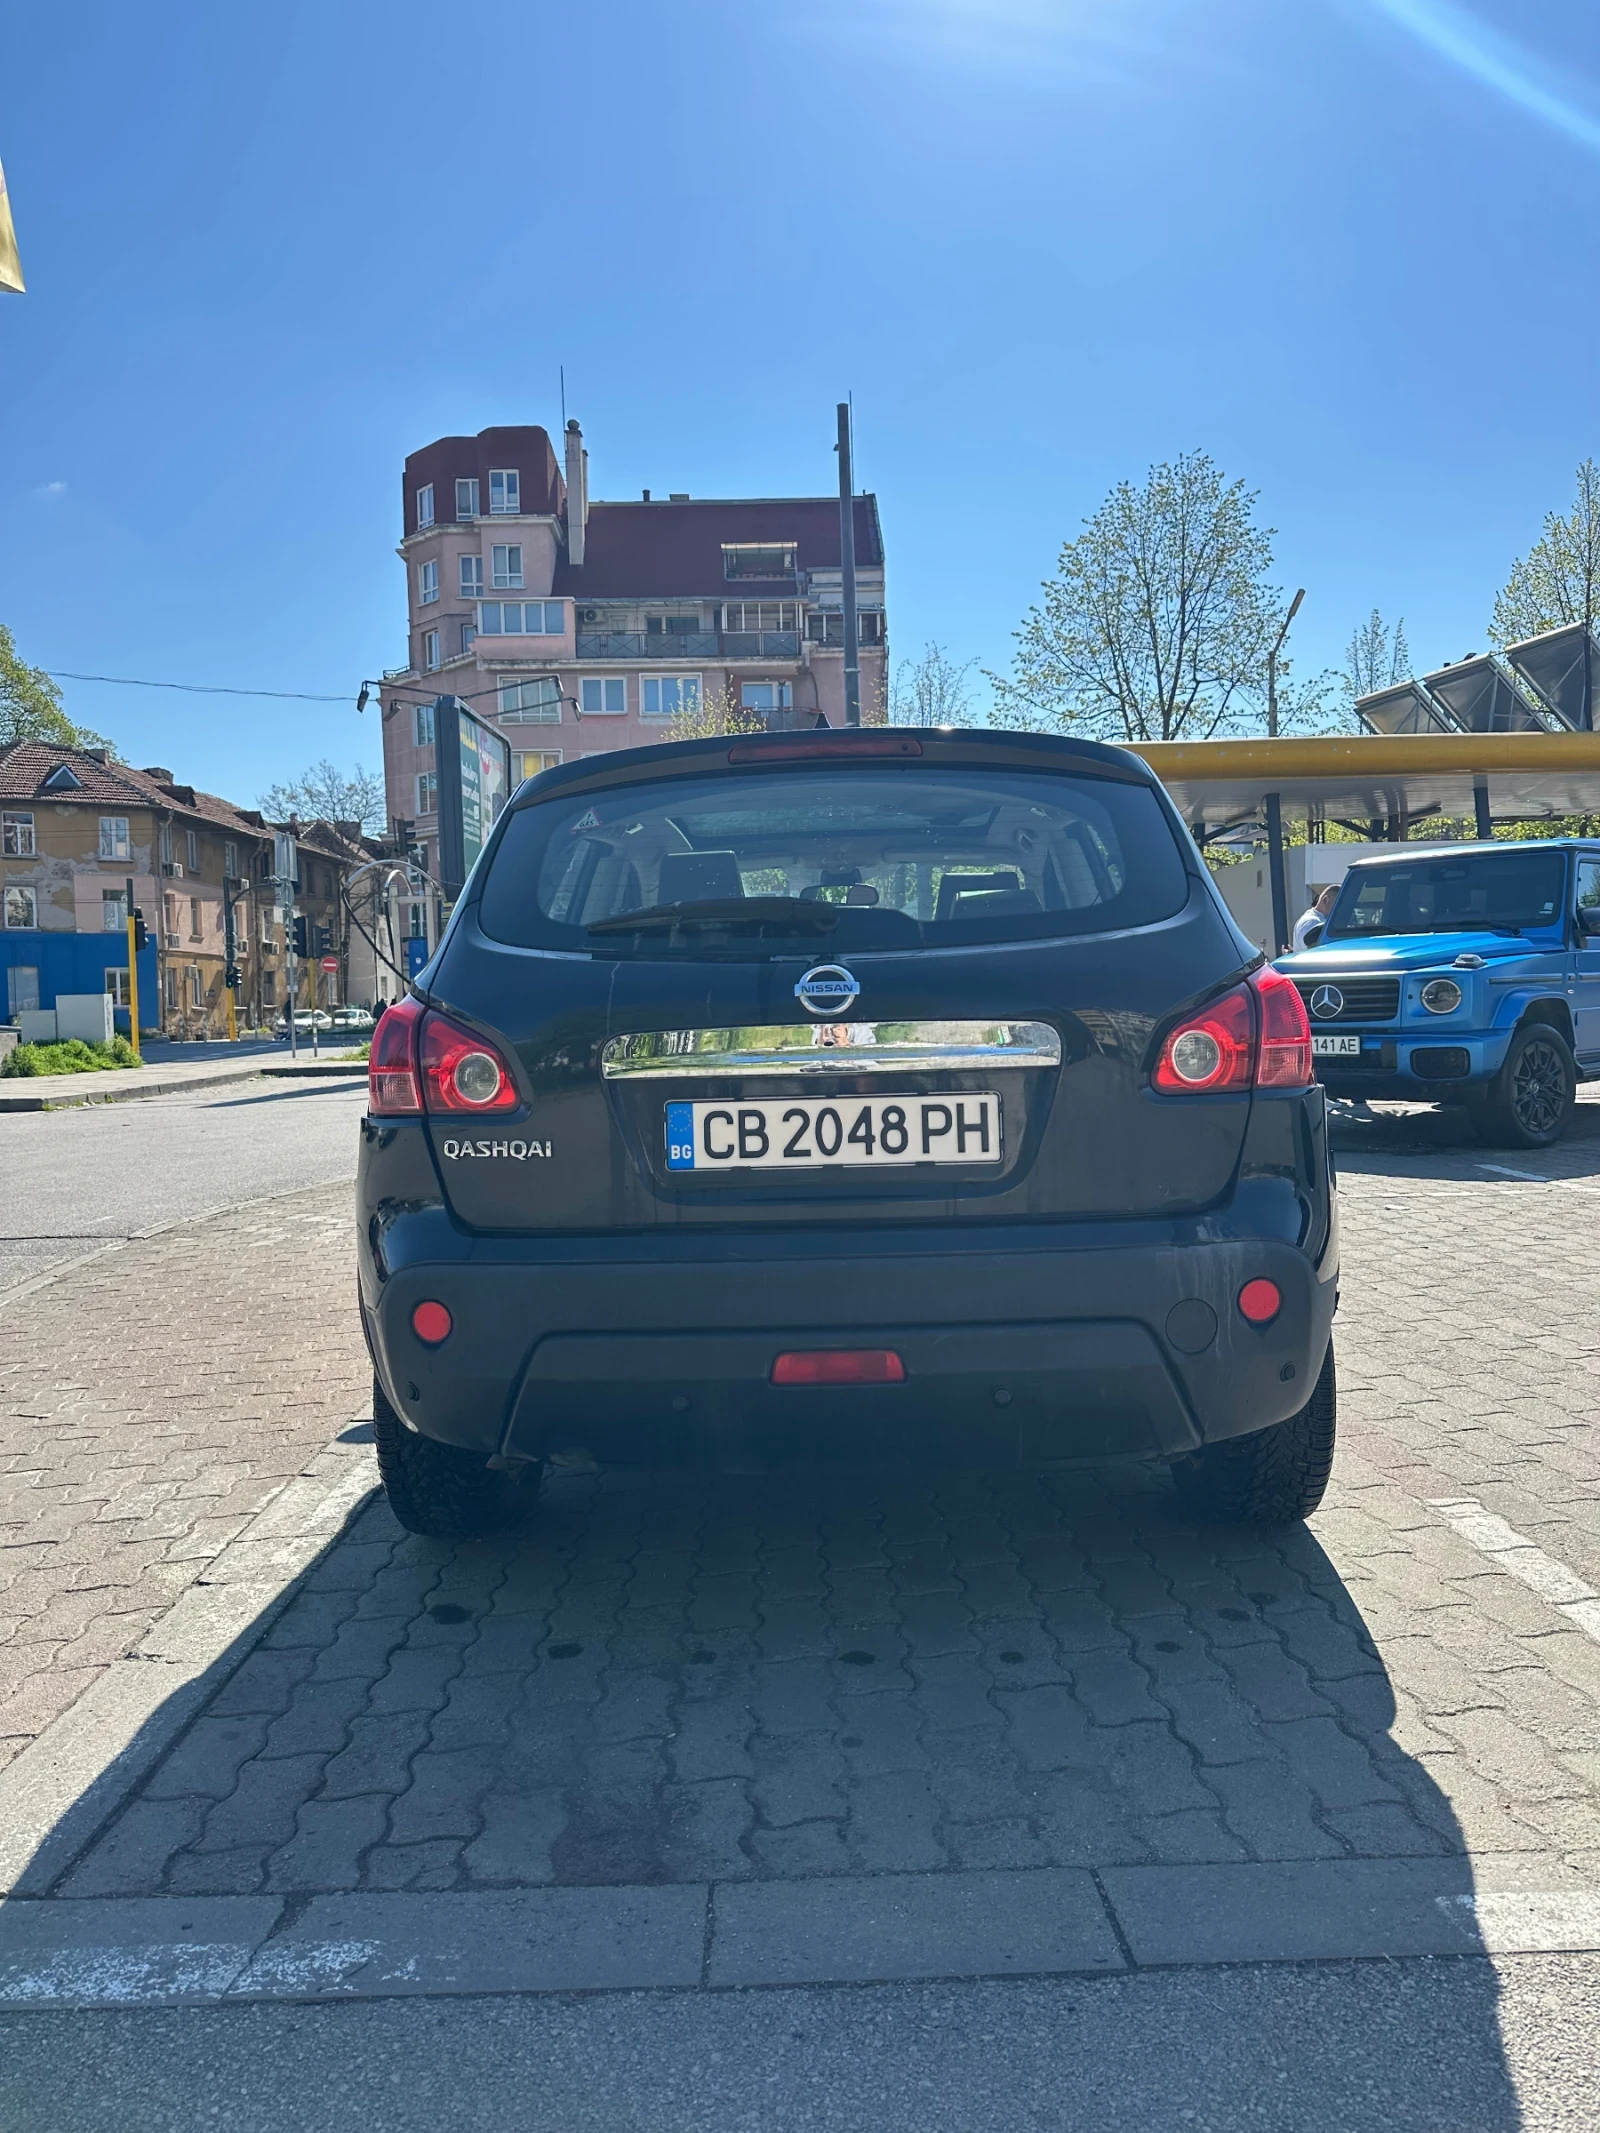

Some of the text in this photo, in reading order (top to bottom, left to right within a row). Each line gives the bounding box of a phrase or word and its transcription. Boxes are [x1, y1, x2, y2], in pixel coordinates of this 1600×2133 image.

[579, 820, 594, 828] GAS
[801, 984, 853, 993] NISSAN
[1314, 1038, 1357, 1052] 141 AE
[703, 1101, 990, 1160] CB 2048 PH
[443, 1139, 552, 1160] QASHQAI
[670, 1144, 692, 1160] BG
